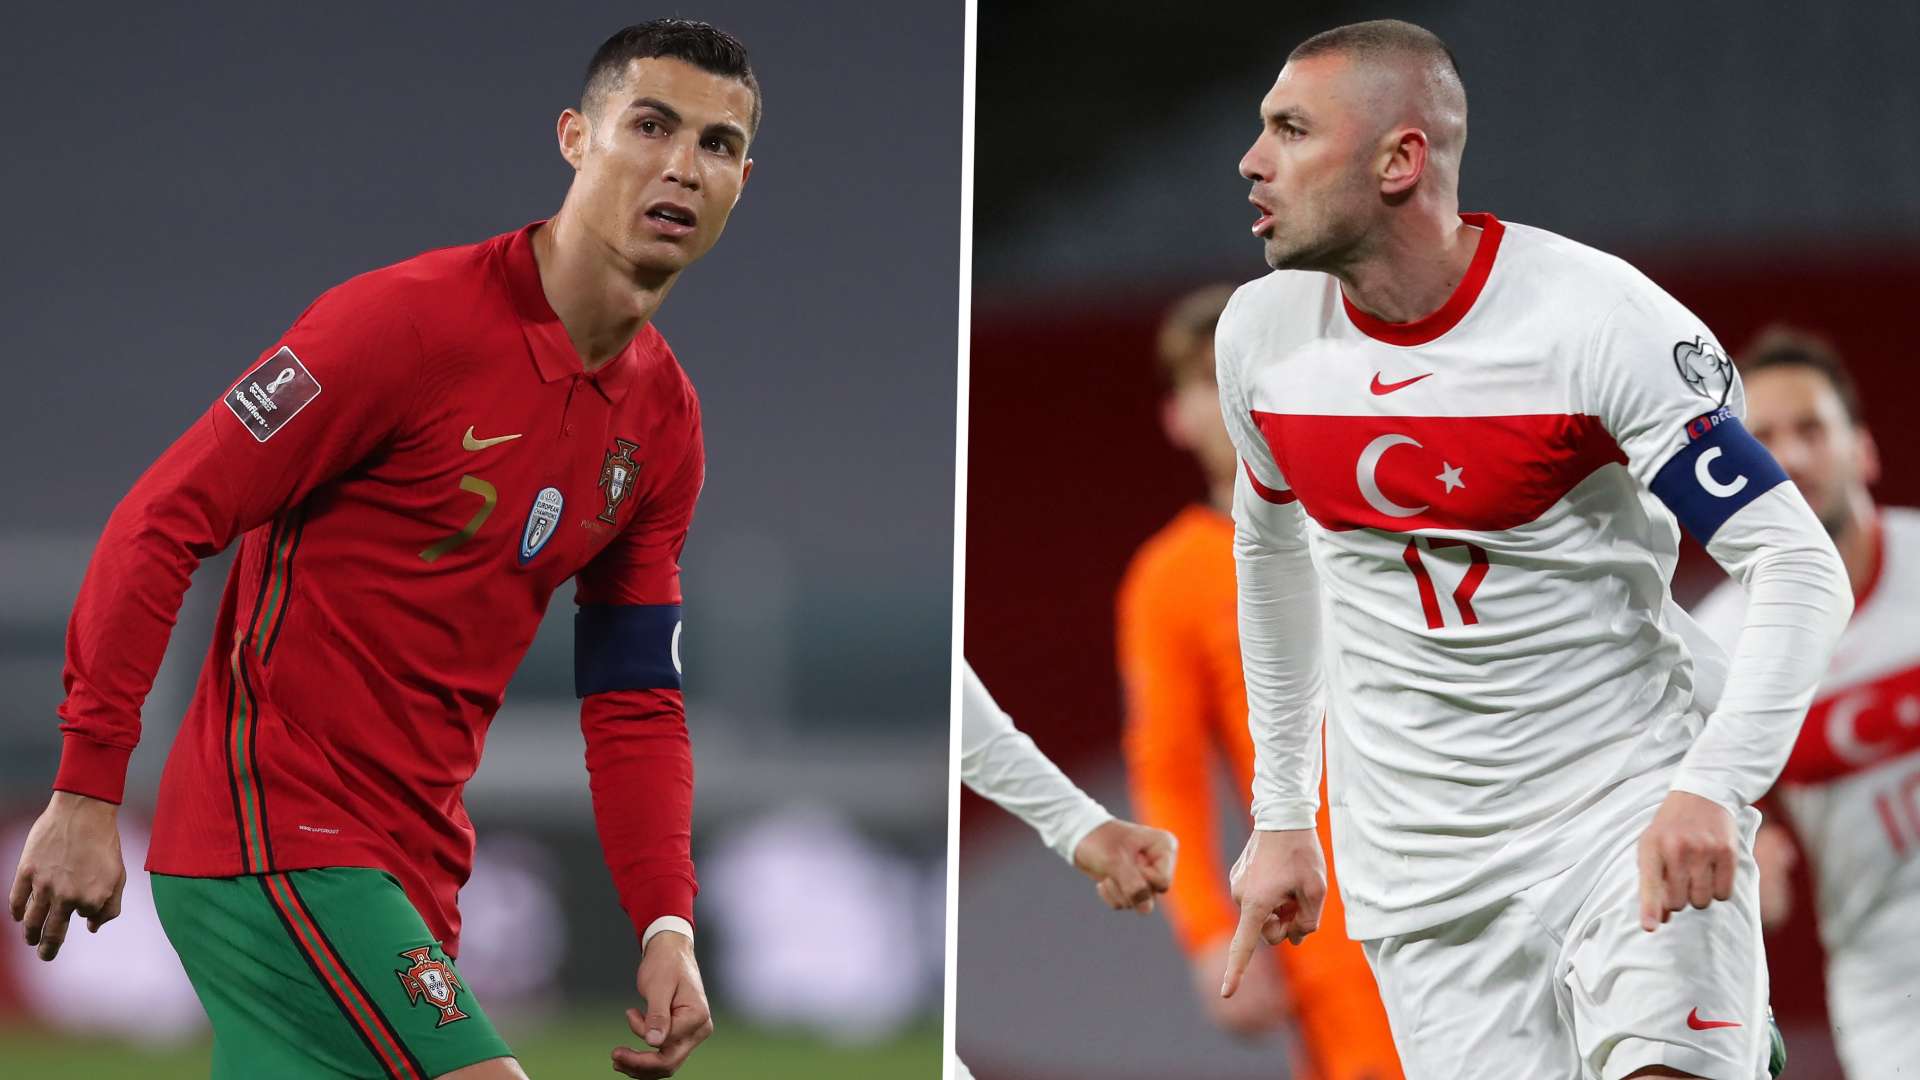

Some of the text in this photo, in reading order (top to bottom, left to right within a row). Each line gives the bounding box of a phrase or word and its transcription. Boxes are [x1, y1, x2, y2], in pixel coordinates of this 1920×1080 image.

[236, 391, 266, 425] Qualifiers
[1695, 446, 1748, 497] C
[418, 474, 497, 563] 7
[534, 508, 558, 520] CHAMPIONS
[537, 501, 560, 513] EUROPEAN
[1402, 536, 1490, 630] 17
